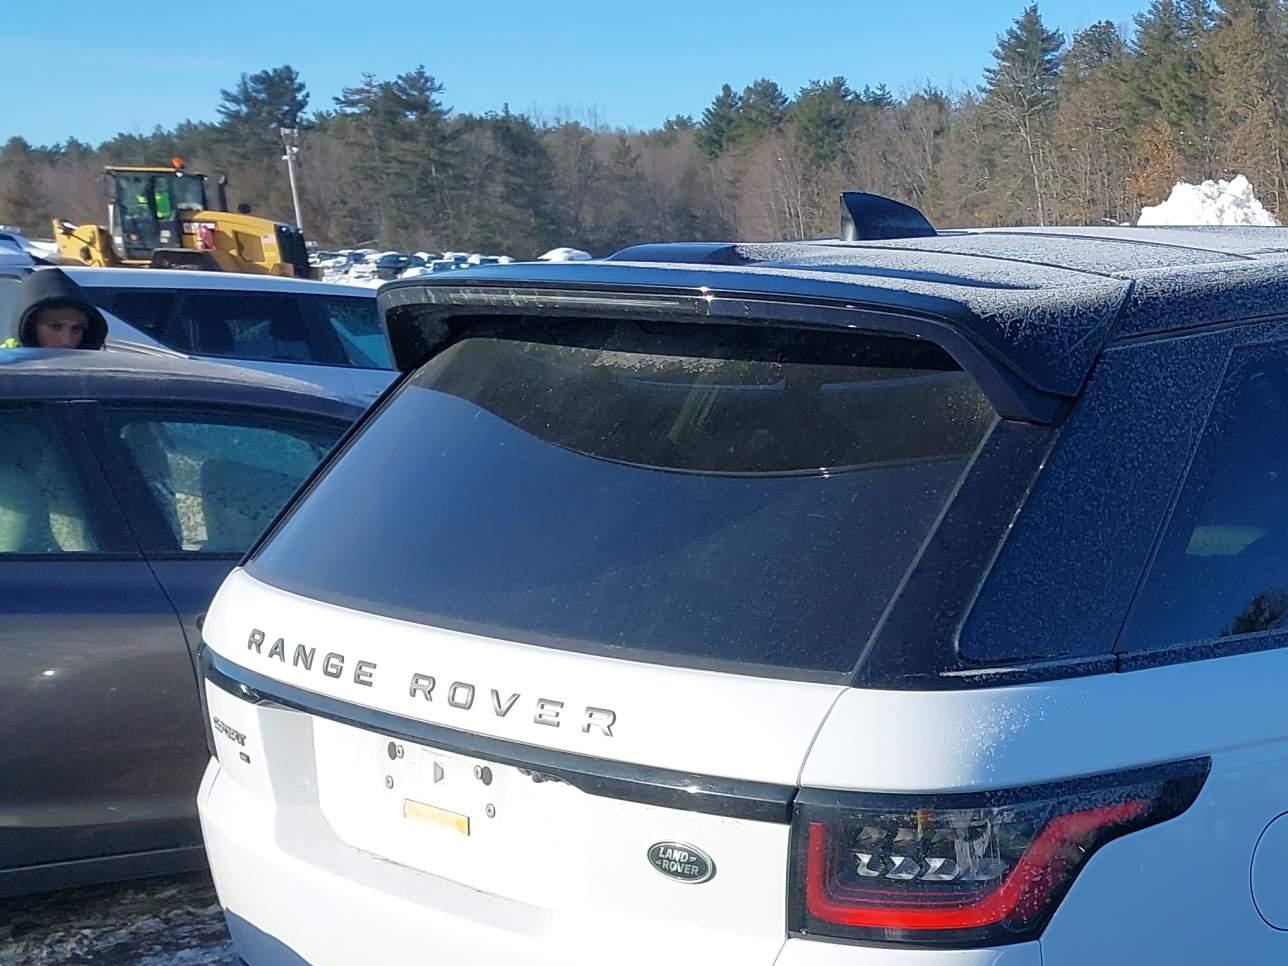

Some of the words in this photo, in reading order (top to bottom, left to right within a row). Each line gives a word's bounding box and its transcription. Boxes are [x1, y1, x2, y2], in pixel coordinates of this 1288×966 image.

[247, 628, 377, 687] RANGE
[409, 672, 617, 737] ROVER
[658, 846, 689, 862] LAND
[661, 859, 700, 876] ROVER
